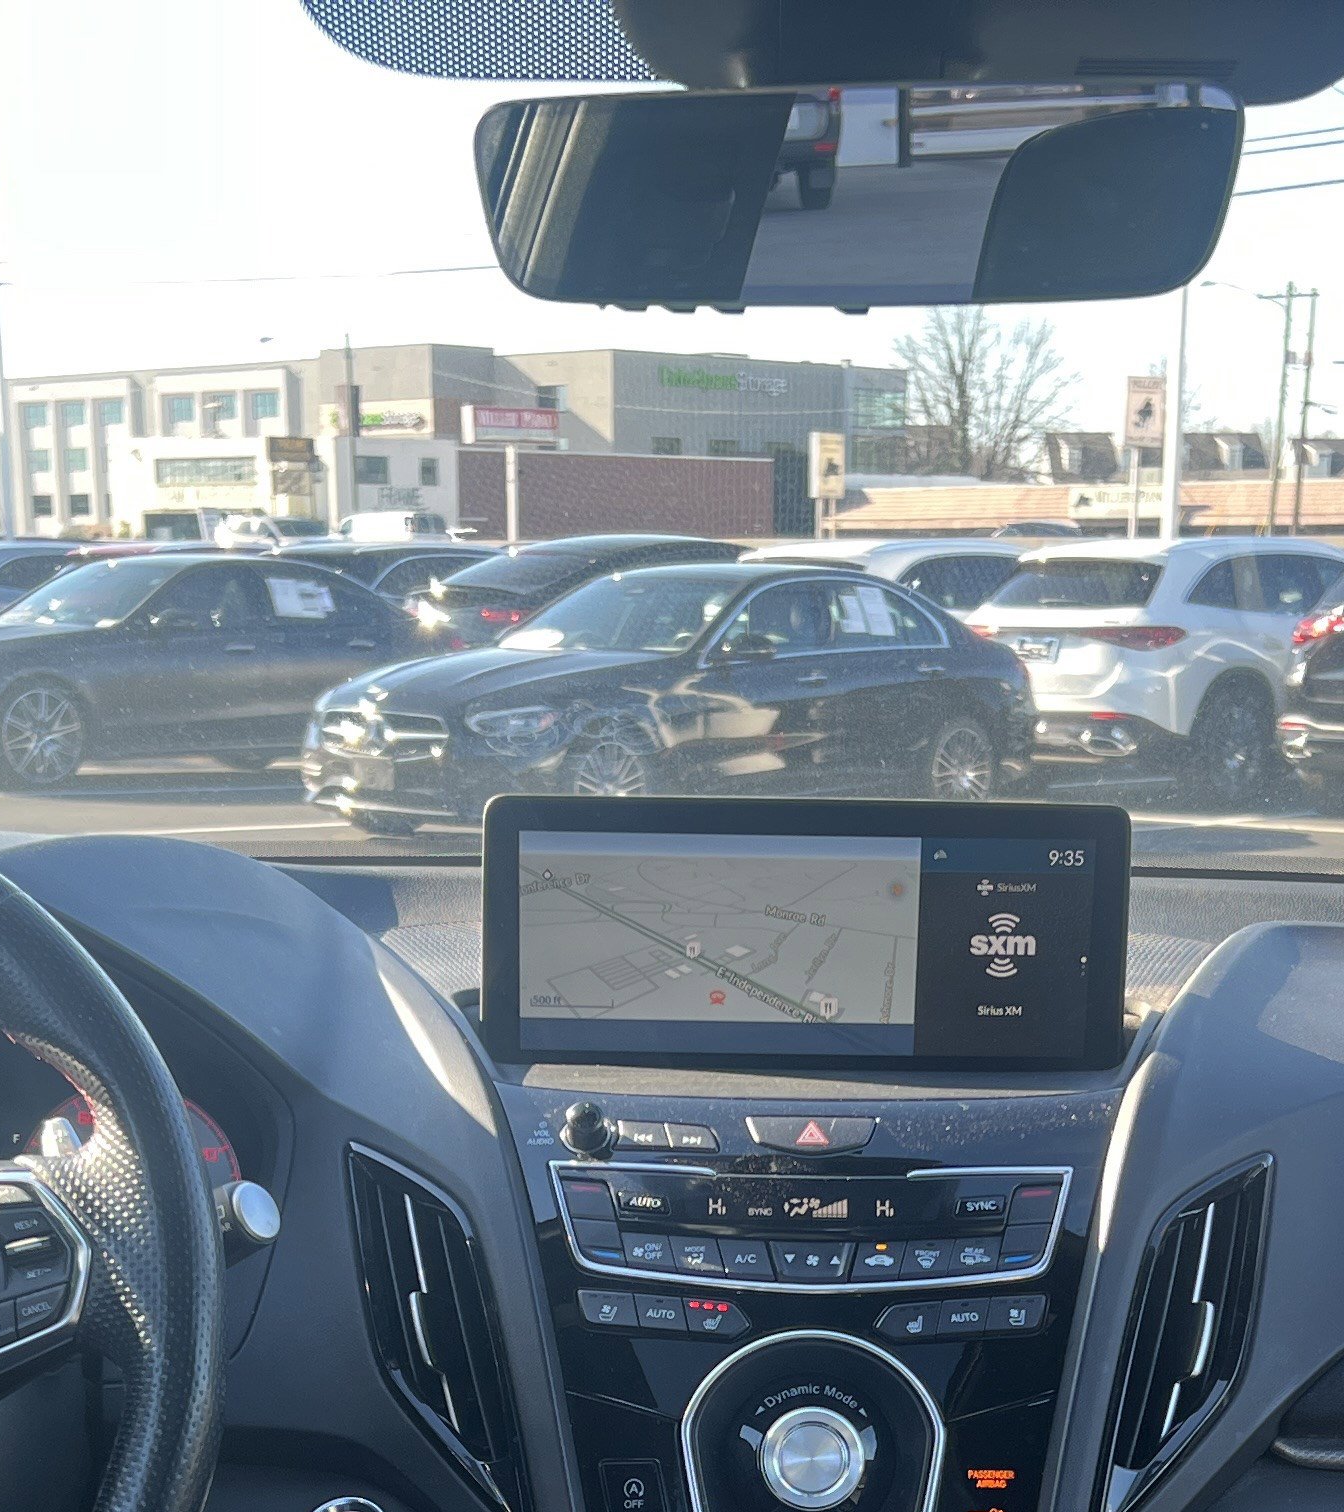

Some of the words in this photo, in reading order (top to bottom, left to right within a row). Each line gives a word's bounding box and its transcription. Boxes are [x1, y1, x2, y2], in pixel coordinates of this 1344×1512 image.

[1048, 850, 1085, 866] 9:35
[519, 877, 573, 896] onference
[575, 872, 591, 885] Dr
[997, 882, 1037, 892] SiriusXM
[765, 905, 806, 924] Monroe
[810, 913, 826, 926] Rd
[970, 935, 1036, 956] sxm
[532, 995, 552, 1005] 500
[727, 973, 802, 1020] Independence
[977, 1005, 1004, 1016] Sirius
[1005, 1006, 1022, 1016] XM
[12, 1134, 21, 1144] F
[527, 1137, 555, 1146] AUDIO
[629, 1196, 661, 1209] AUTO
[966, 1200, 998, 1212] SYNC
[748, 1207, 773, 1217] SYNC
[645, 1251, 663, 1261] OFF
[734, 1254, 757, 1264] A/C
[914, 1250, 940, 1258] FRONT
[22, 1300, 52, 1317] CANCEL
[646, 1308, 675, 1321] AUTO
[951, 1312, 979, 1323] AUTO
[763, 1383, 820, 1408] Dynamic
[823, 1385, 858, 1409] Mode
[968, 1469, 1015, 1480] PASSENGER
[976, 1479, 1007, 1489] AIRBAG
[623, 1498, 644, 1510] OFF
